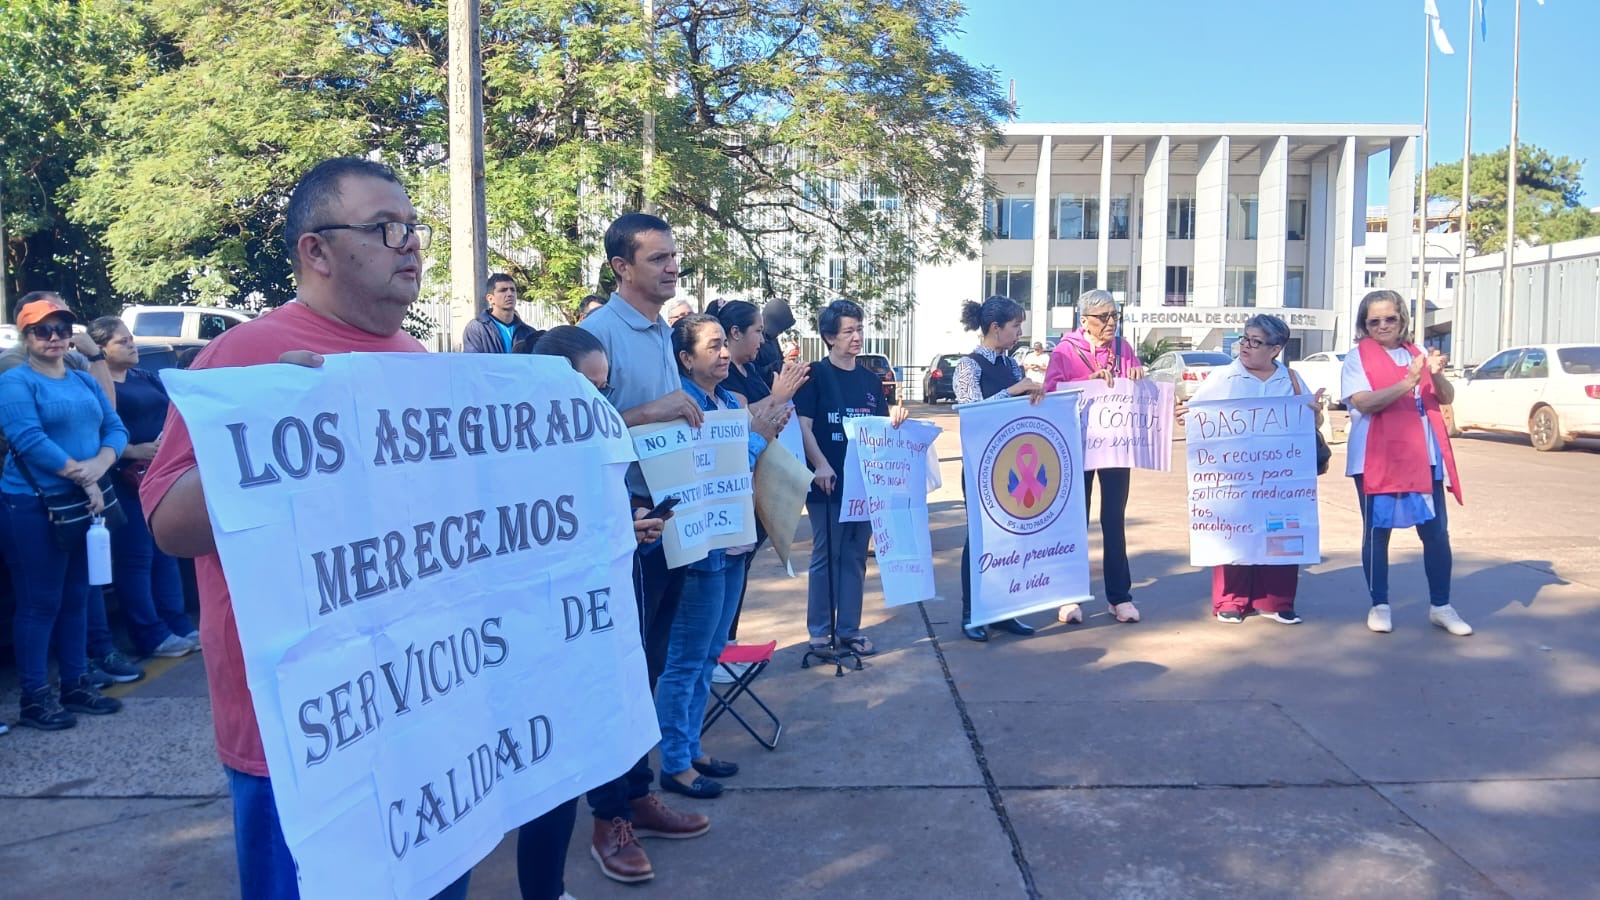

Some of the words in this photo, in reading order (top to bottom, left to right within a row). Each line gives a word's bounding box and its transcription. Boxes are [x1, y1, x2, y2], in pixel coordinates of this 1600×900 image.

[1141, 312, 1201, 324] REGIONAL
[1205, 312, 1222, 324] DE
[1223, 312, 1256, 325] CIUD
[1290, 314, 1317, 326] ESTE
[225, 411, 346, 488] LOS
[373, 398, 623, 467] ASEGURADOS
[644, 435, 667, 451] NO
[676, 430, 687, 444] A
[690, 428, 702, 441] LA
[710, 421, 745, 439] FUSIÓN
[695, 453, 711, 468] DEL
[1198, 449, 1217, 465] De
[1223, 449, 1283, 464] recursos
[1286, 443, 1302, 459] de
[702, 482, 714, 496] DE
[717, 477, 749, 494] SALUD
[1193, 471, 1254, 487] amparos
[1261, 469, 1294, 485] para
[1192, 503, 1213, 518] tos
[684, 519, 704, 538] CON
[310, 494, 579, 616] MERECEMOS
[979, 551, 1020, 574] Donde
[1023, 542, 1076, 569] prevalece
[1009, 578, 1021, 594] la
[1025, 573, 1050, 589] vida
[298, 616, 510, 768] SERVICIOS
[561, 587, 615, 642] DE
[387, 713, 554, 860] CALIDAD
